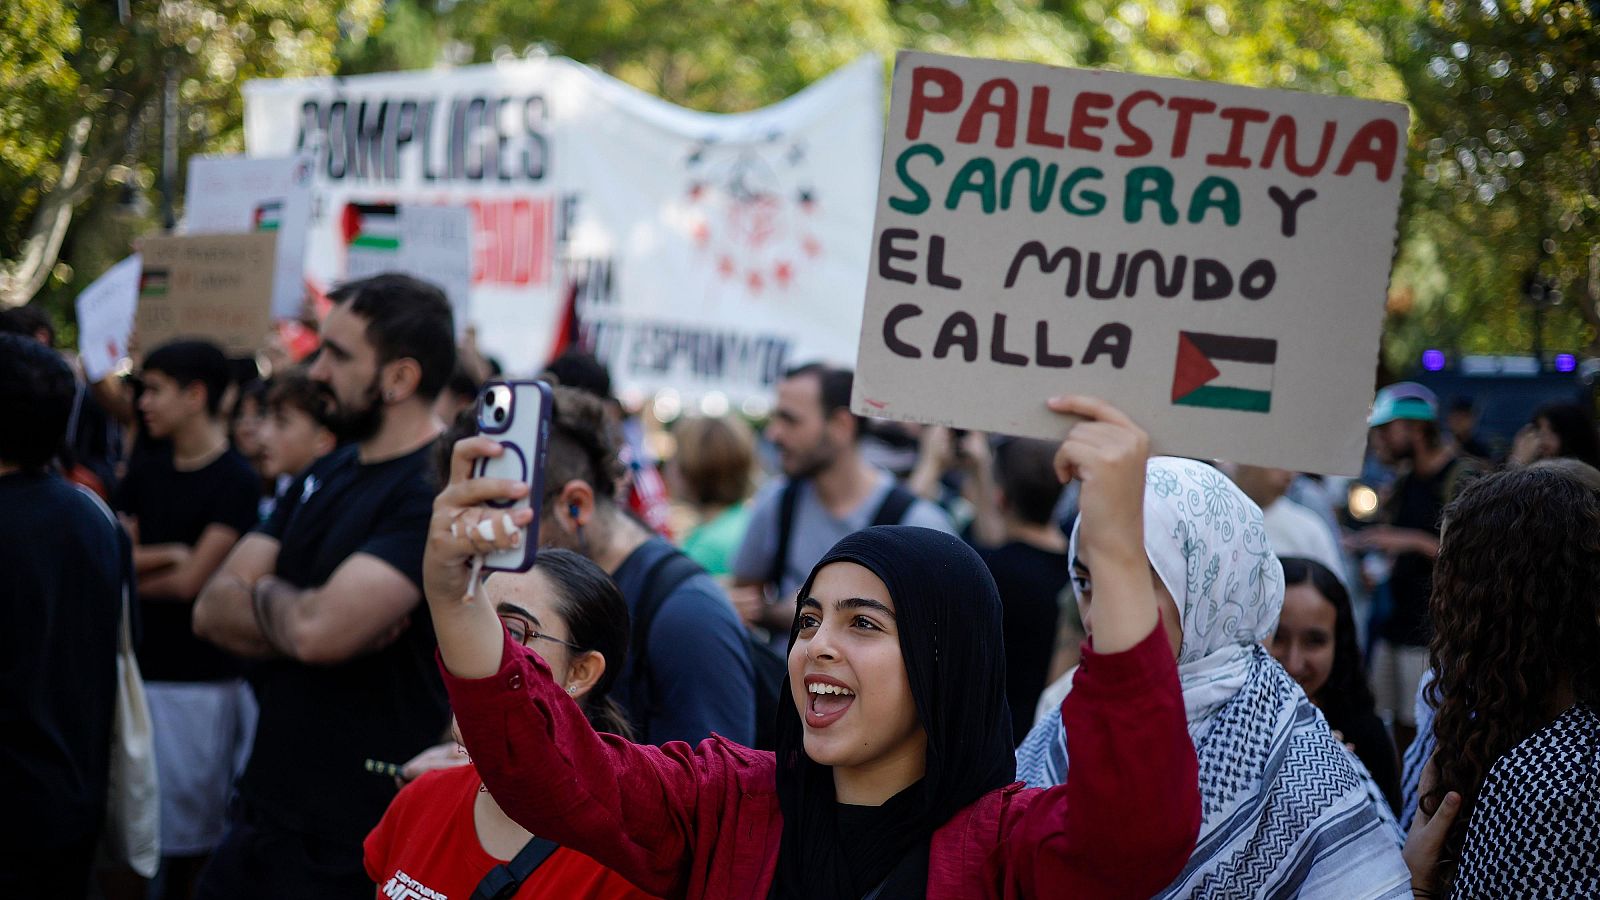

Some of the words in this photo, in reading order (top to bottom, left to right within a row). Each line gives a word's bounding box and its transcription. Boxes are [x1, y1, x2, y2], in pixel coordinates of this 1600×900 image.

[904, 65, 1399, 182] PALESTINA
[888, 143, 1241, 227] SANGRA
[1267, 185, 1317, 238] Y
[878, 227, 962, 290] EL
[1004, 240, 1277, 301] MUNDO
[882, 303, 1133, 370] CALLA
